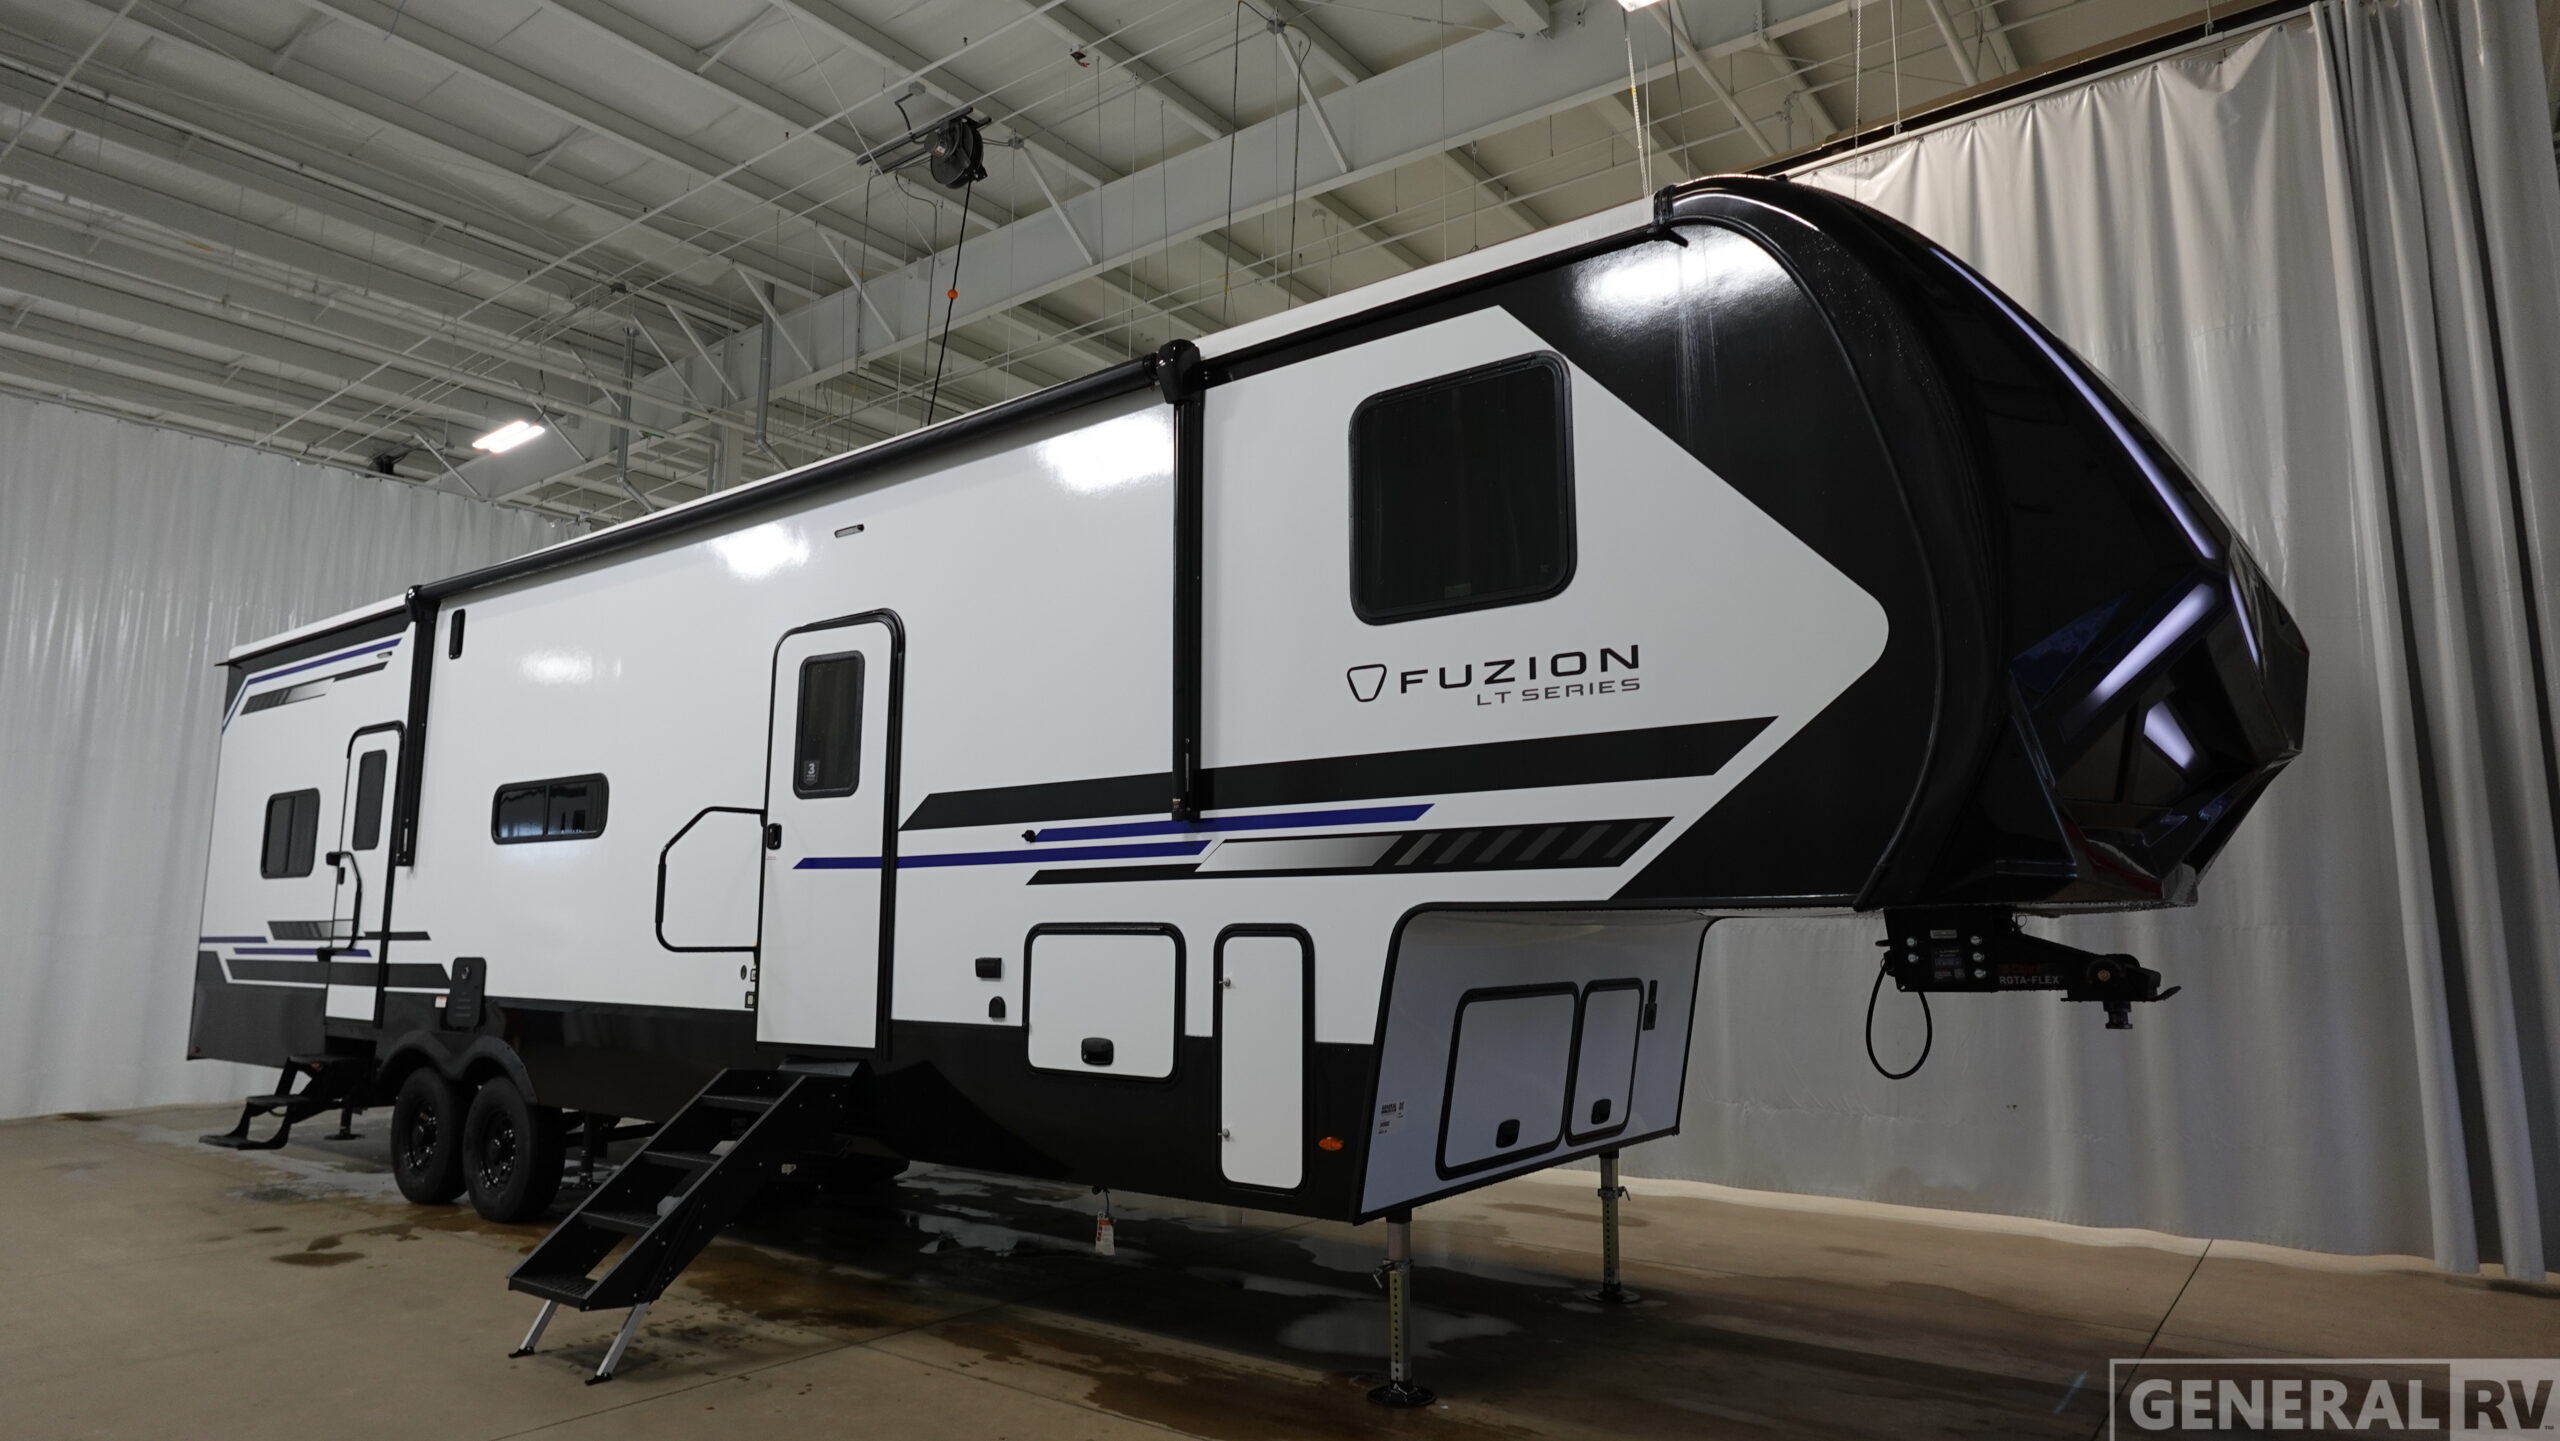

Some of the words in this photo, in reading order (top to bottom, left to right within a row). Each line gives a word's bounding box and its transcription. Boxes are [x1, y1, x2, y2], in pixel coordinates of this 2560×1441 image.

[1400, 644, 1640, 694] FUZION
[1476, 691, 1512, 707] LT
[1521, 678, 1641, 702] SERIES
[807, 762, 816, 775] 3
